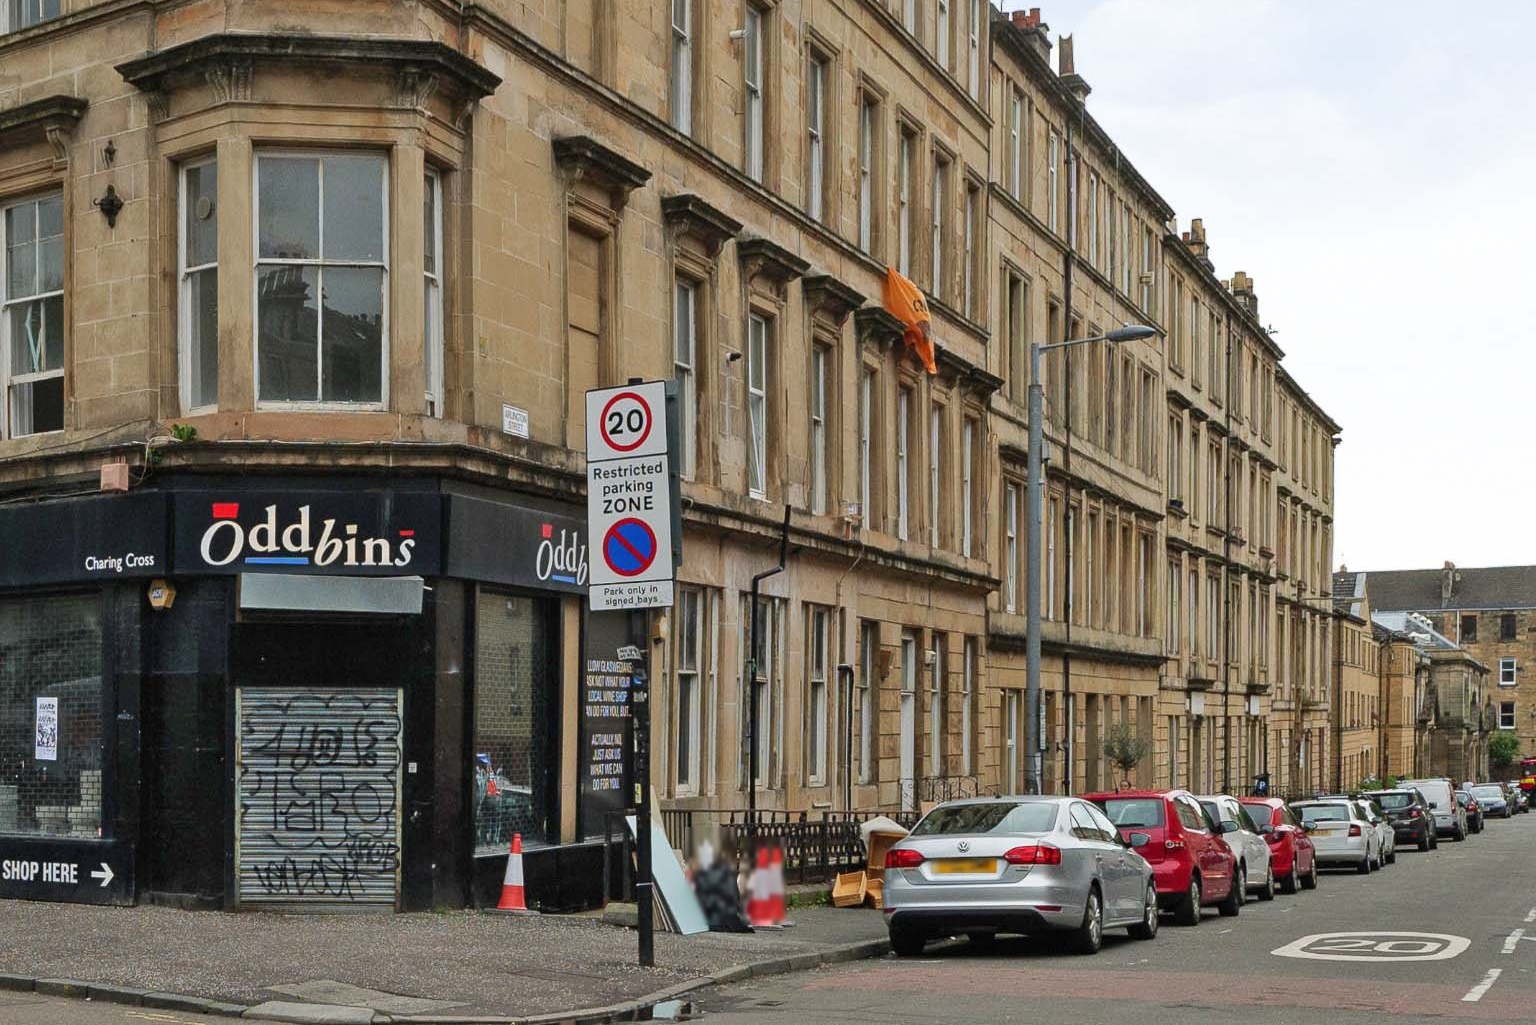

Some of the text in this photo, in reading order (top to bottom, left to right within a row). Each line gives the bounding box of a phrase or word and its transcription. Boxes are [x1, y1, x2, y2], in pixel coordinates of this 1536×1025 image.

[608, 409, 644, 435] 20
[593, 461, 663, 480] Restricted
[603, 480, 653, 496] parking
[603, 496, 654, 514] ZONE
[200, 504, 416, 566] Oddbins
[85, 556, 123, 572] Charing
[125, 553, 155, 567] Cross
[535, 528, 588, 585] Oddb
[604, 584, 658, 596] Park only in
[605, 595, 658, 607] signed bays
[587, 660, 600, 673] LLOW
[613, 763, 623, 775] CAN
[2, 860, 39, 881] SHOP
[42, 862, 78, 884] HERE
[1310, 940, 1442, 953] 20
